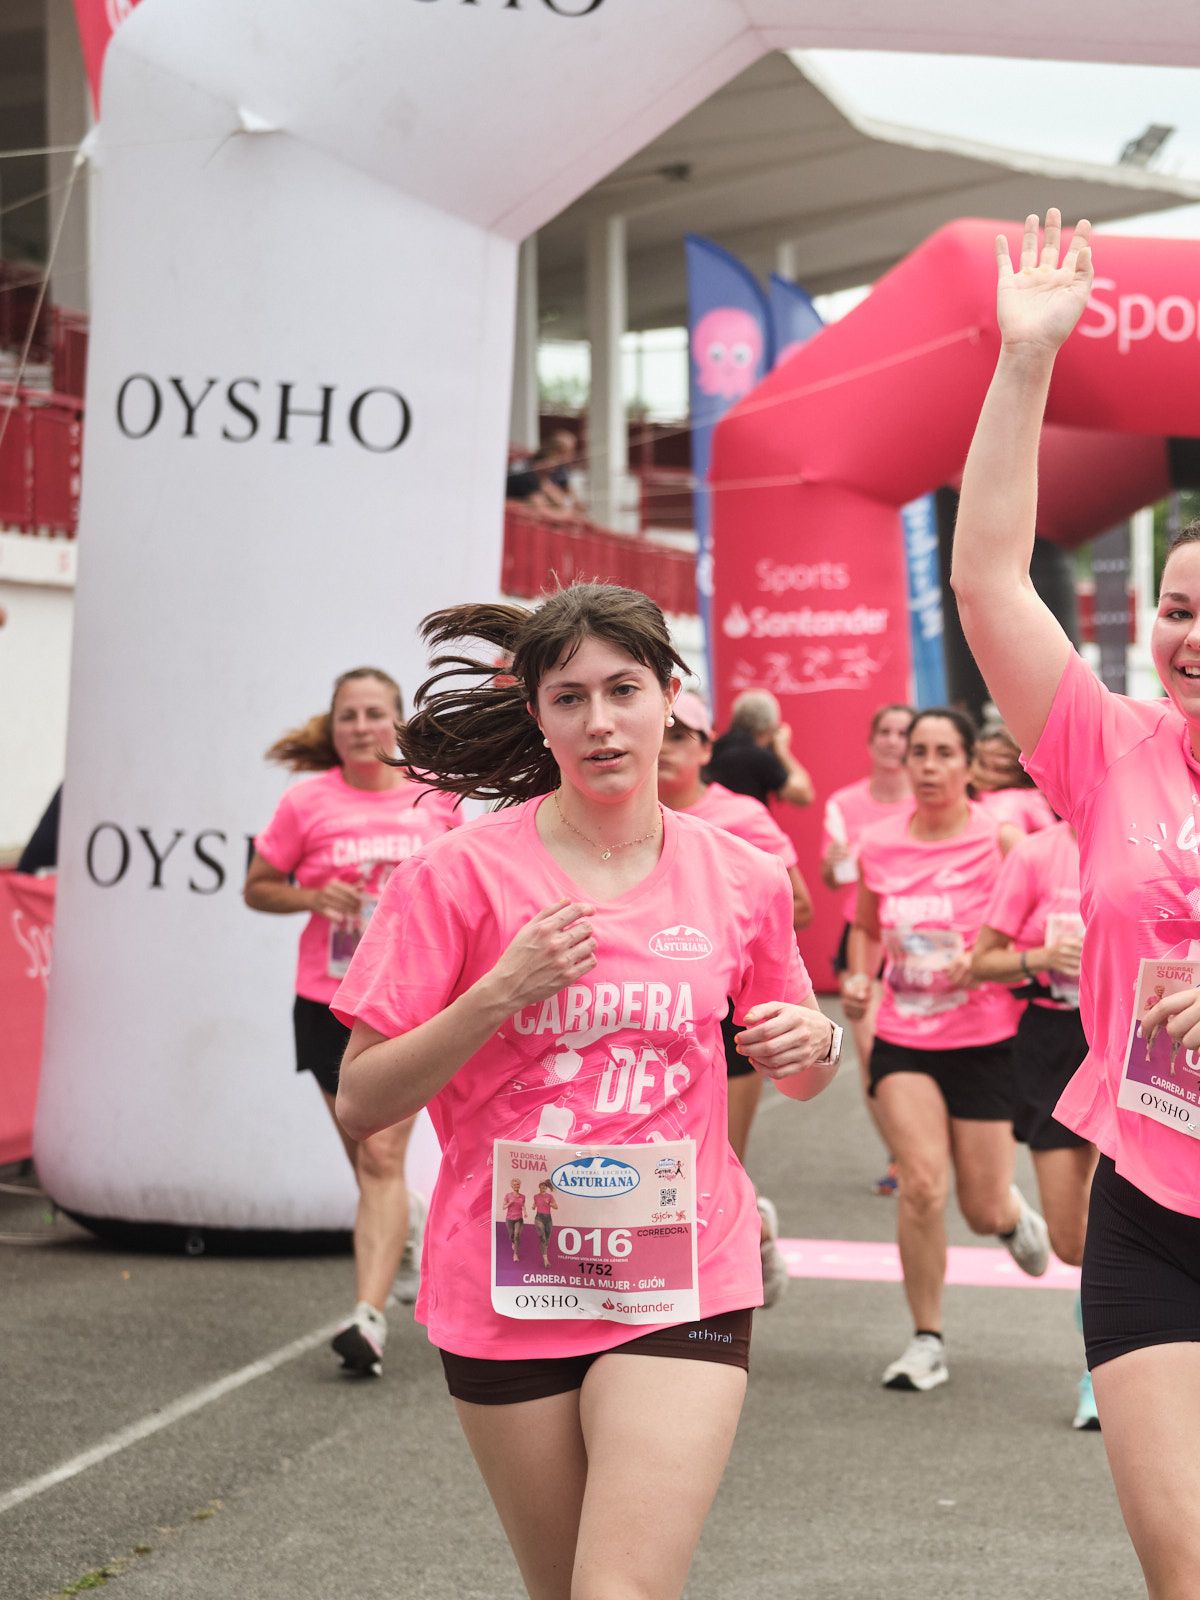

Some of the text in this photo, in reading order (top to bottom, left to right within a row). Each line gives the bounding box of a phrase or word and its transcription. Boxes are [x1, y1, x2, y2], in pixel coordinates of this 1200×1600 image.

[116, 373, 414, 453] OYSHO
[755, 558, 850, 597] Sports
[750, 605, 889, 639] Santander
[86, 821, 257, 895] OYS
[655, 938, 709, 952] ASTURIANA
[1157, 970, 1193, 985] SUMA
[1150, 1075, 1185, 1097] CARRERA
[1186, 1090, 1196, 1102] DE
[1140, 1092, 1190, 1123] OYSHO
[520, 1153, 548, 1161] DORSAL
[511, 1159, 548, 1173] SUMA
[558, 1171, 635, 1187] ASTURIANA
[637, 1226, 689, 1238] CORREDORA
[557, 1227, 633, 1258] 016
[578, 1262, 613, 1276] 1752
[522, 1273, 665, 1290] CARRERA DE LA MUJER GIJÓN
[515, 1294, 579, 1309] OYSHO
[616, 1301, 675, 1314] Santander
[688, 1329, 732, 1344] athiral
